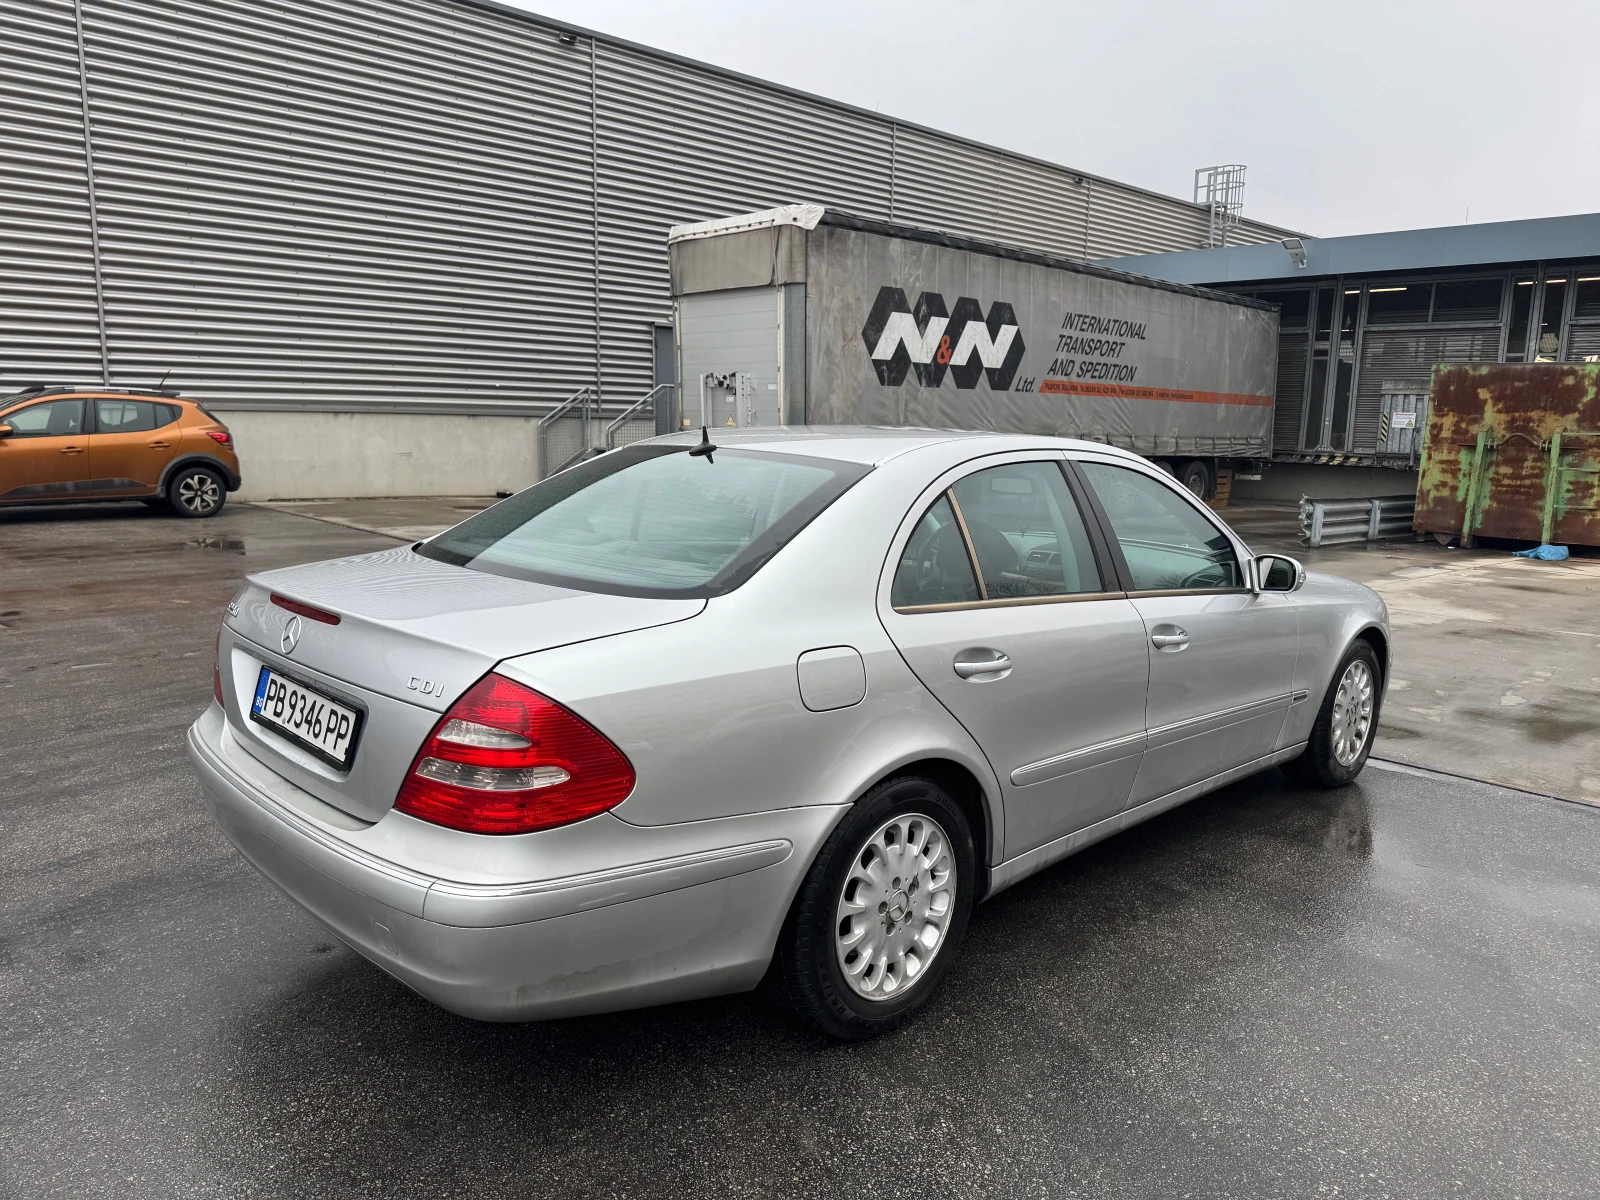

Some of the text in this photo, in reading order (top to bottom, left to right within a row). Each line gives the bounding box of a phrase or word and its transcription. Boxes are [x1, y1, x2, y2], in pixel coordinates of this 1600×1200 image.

[1061, 312, 1147, 340] INTERNATIONAL
[871, 311, 1019, 369] N&N
[1055, 334, 1126, 358] TRANSPORT
[1047, 358, 1138, 382] AND SPEDITION
[1014, 376, 1036, 393] Ltd.
[406, 675, 445, 698] CDI
[263, 677, 287, 718] PB
[286, 689, 325, 739] 9346
[322, 708, 350, 750] PP
